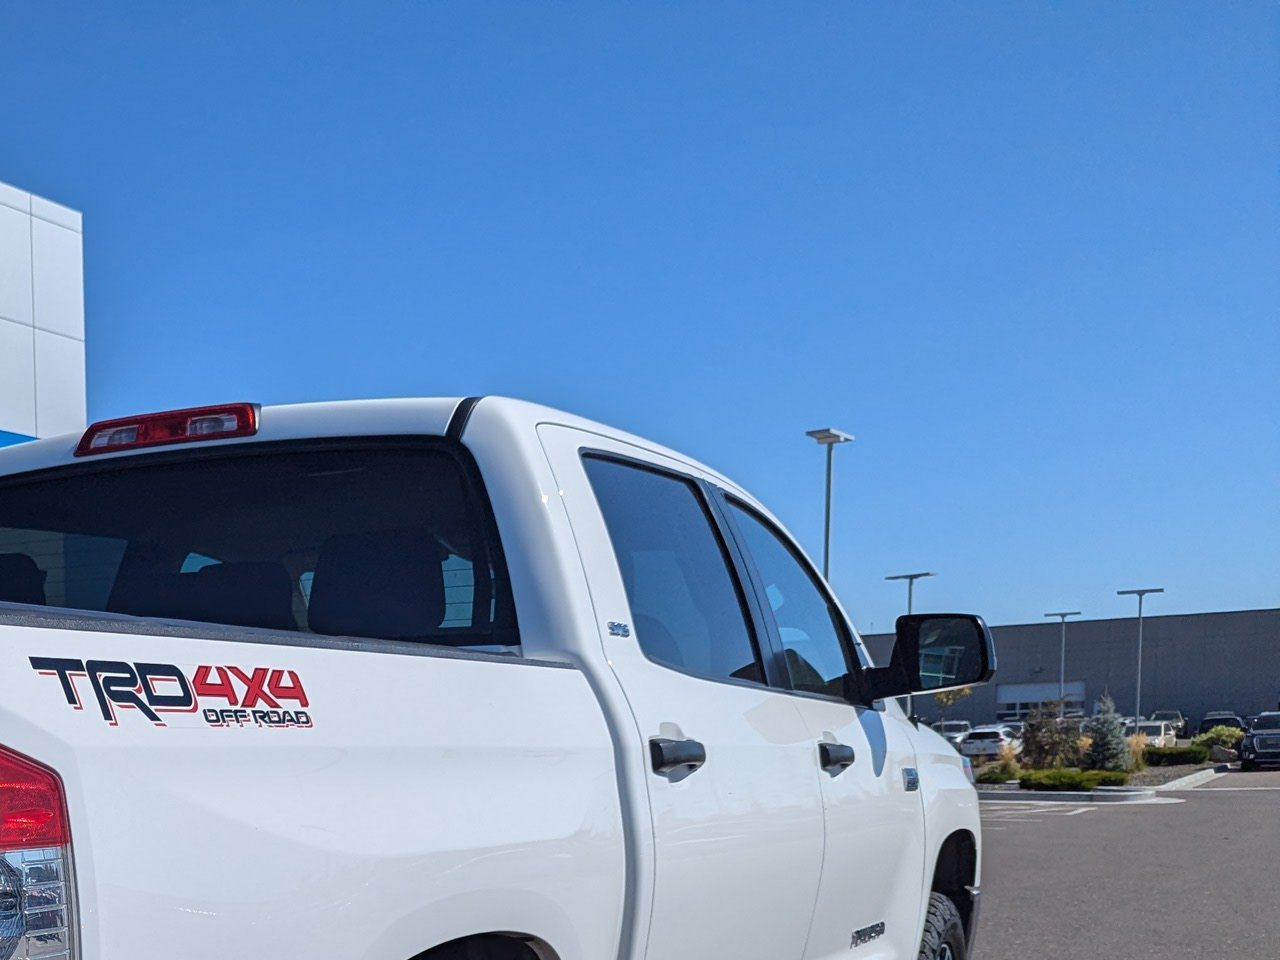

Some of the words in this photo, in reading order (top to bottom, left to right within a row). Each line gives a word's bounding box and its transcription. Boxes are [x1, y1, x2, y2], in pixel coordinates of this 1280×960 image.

[29, 656, 198, 727] TRD
[203, 708, 250, 728] OFF
[252, 709, 314, 729] ROAD
